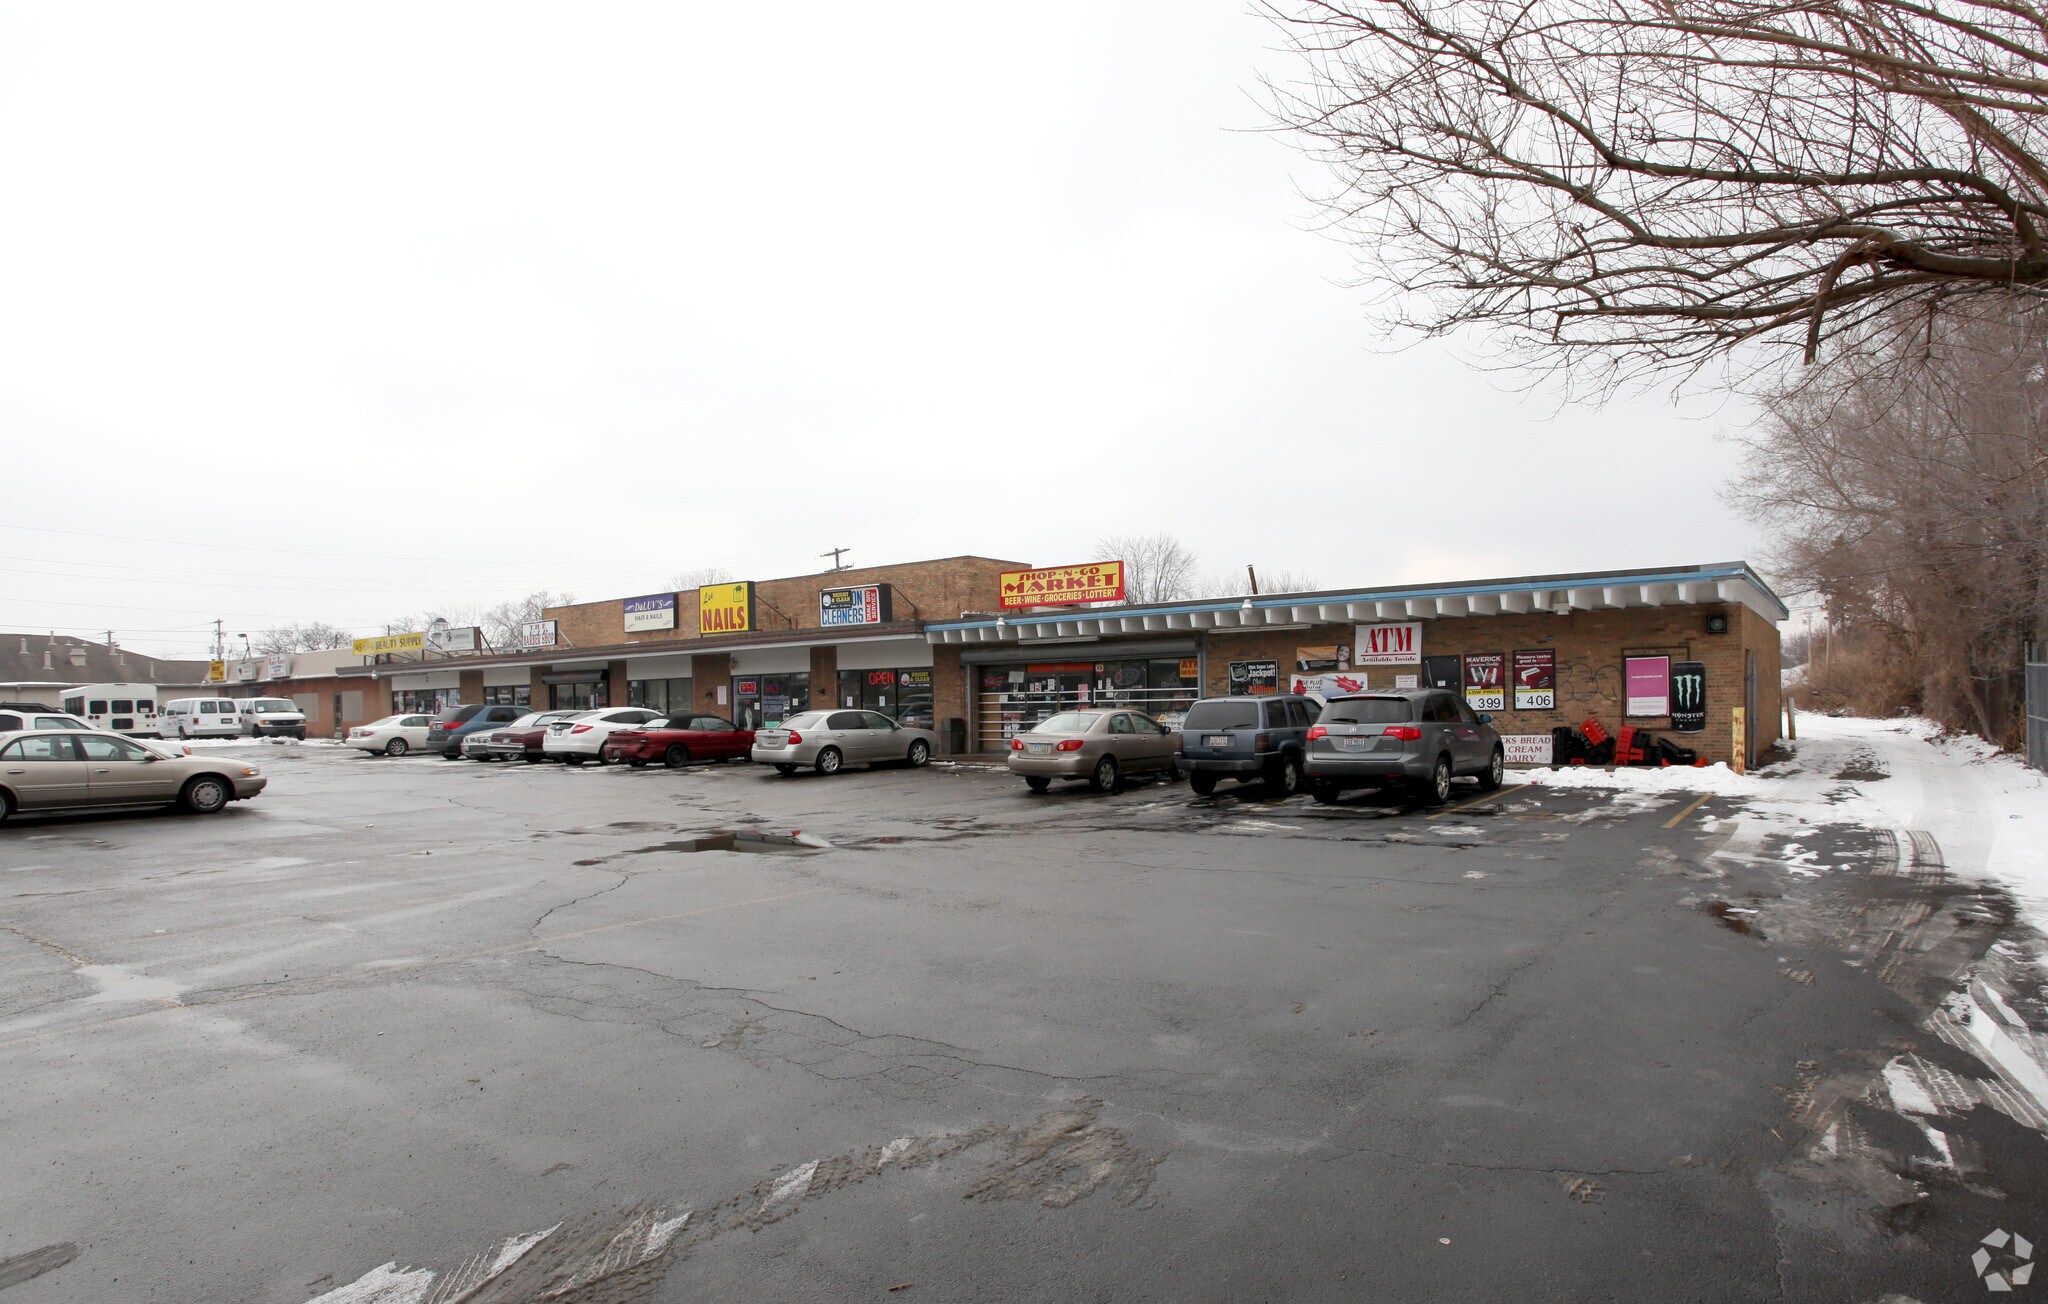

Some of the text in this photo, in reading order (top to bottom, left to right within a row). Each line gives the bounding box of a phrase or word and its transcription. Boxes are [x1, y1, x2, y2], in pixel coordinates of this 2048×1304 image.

[1004, 573, 1117, 594] MARKET
[1044, 591, 1082, 602] GROCERIES
[1085, 588, 1117, 599] LOTTERY
[634, 613, 646, 622] HAIR
[649, 612, 663, 620] NAILS
[702, 606, 745, 632] NAILS
[822, 608, 864, 625] CLEANERS
[375, 640, 397, 650] BEAUTY
[400, 636, 422, 648] SUPPLY
[541, 631, 554, 645] SHOP
[1364, 626, 1413, 653] ATM
[1466, 655, 1501, 663] MAVERICK
[868, 671, 895, 685] OPEN
[1248, 669, 1276, 678] Jackpot!
[1504, 754, 1537, 762] DAIRY
